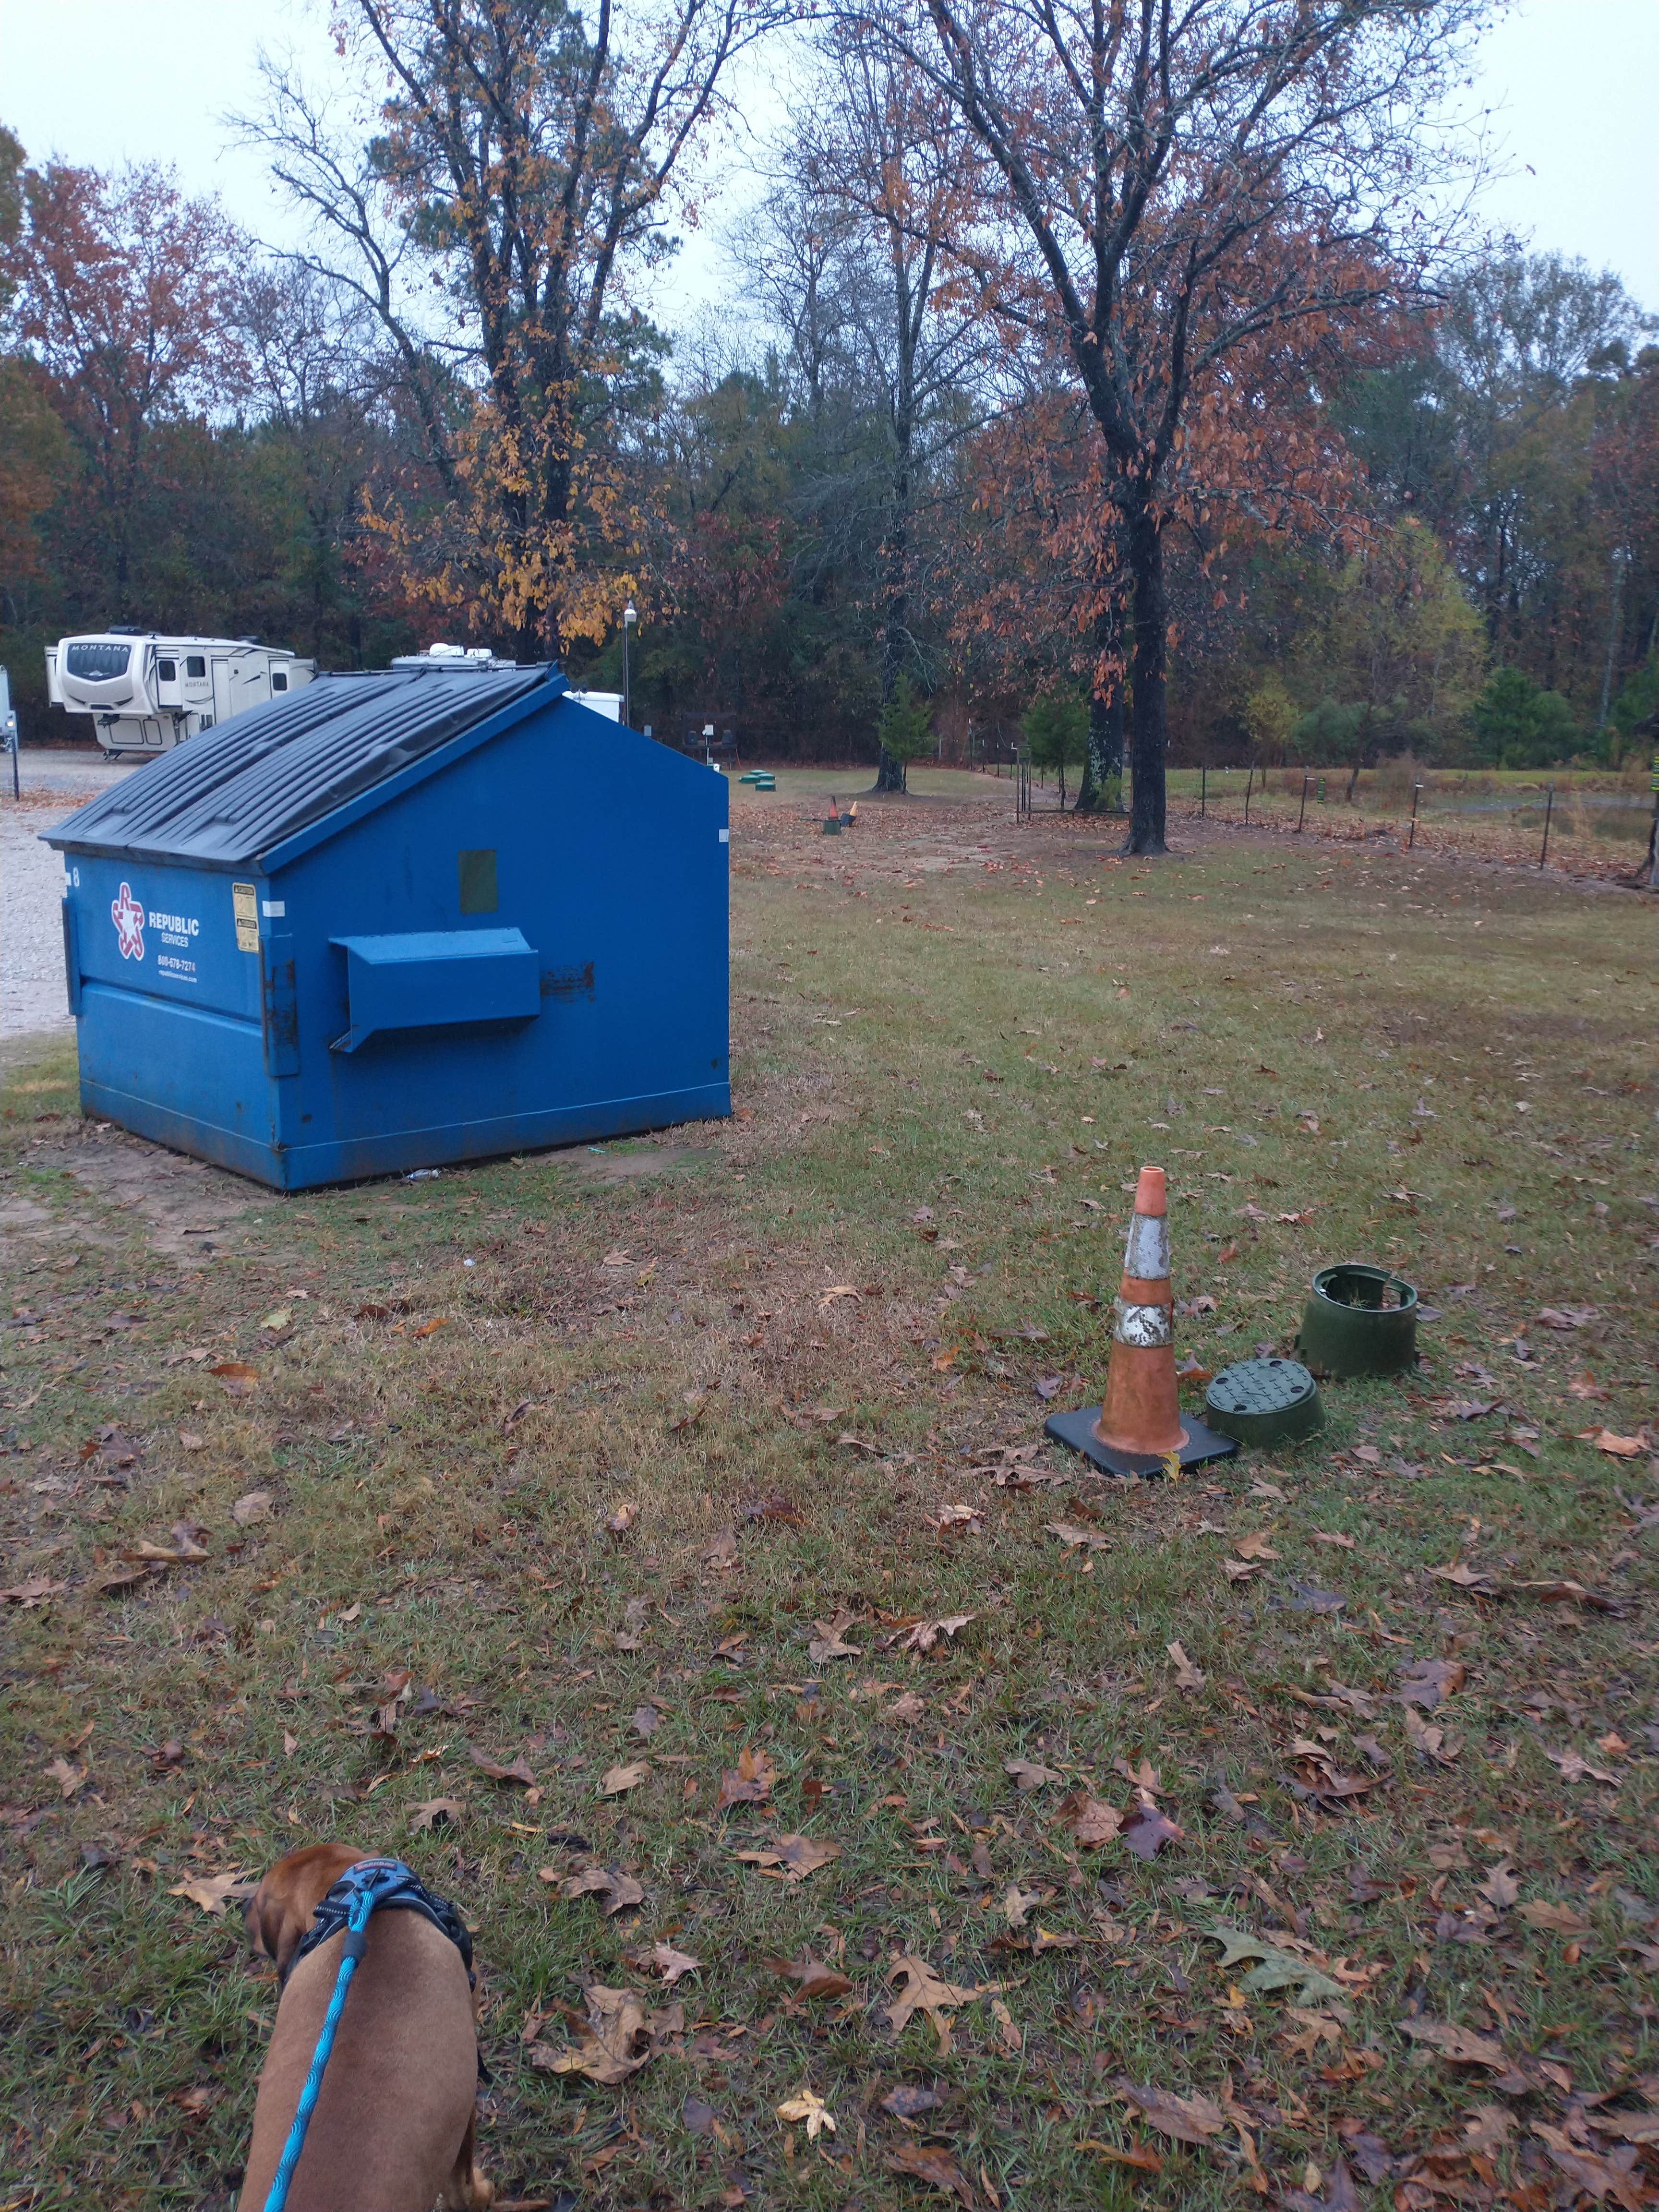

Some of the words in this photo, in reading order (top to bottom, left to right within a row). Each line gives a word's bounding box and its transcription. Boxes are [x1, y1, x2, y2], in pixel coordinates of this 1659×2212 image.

[73, 867, 80, 887] 8
[149, 911, 199, 937] REPUBLIC
[161, 932, 189, 948] SERVICES
